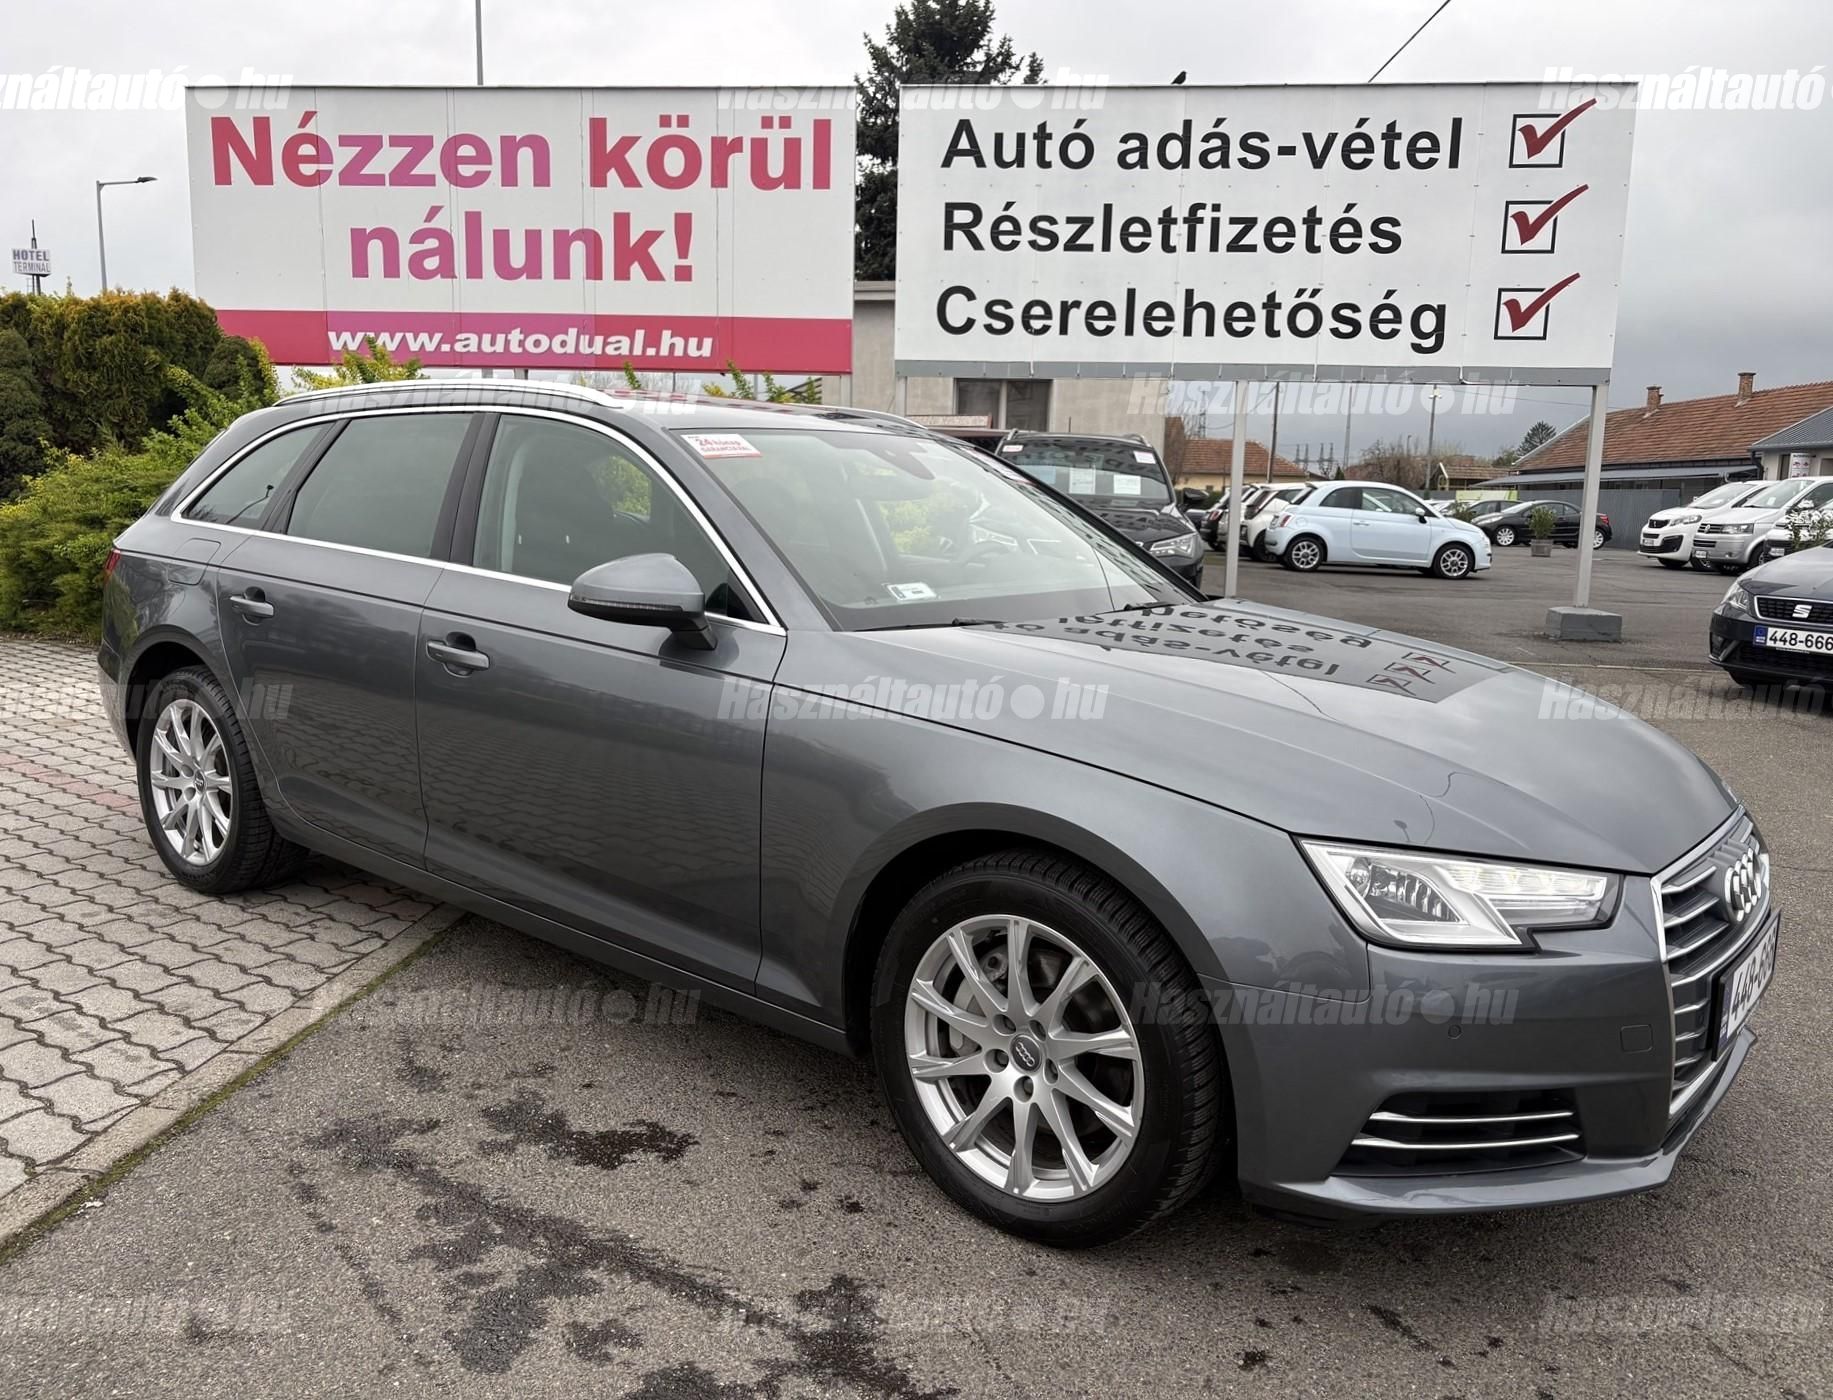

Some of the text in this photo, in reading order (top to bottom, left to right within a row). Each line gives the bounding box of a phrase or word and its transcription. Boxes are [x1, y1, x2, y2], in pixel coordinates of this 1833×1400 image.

[211, 111, 832, 191] Nézzen körül
[941, 117, 1463, 171] Autó adás-vétel
[350, 205, 693, 282] nálunk!
[943, 201, 1402, 255] Részletfizetés
[13, 250, 49, 261] HOTEL
[13, 261, 51, 272] TERMINAL
[327, 327, 713, 358] www.autodual.hu
[936, 285, 1446, 355] Cserelehetőség
[1769, 629, 1833, 651] 448-666
